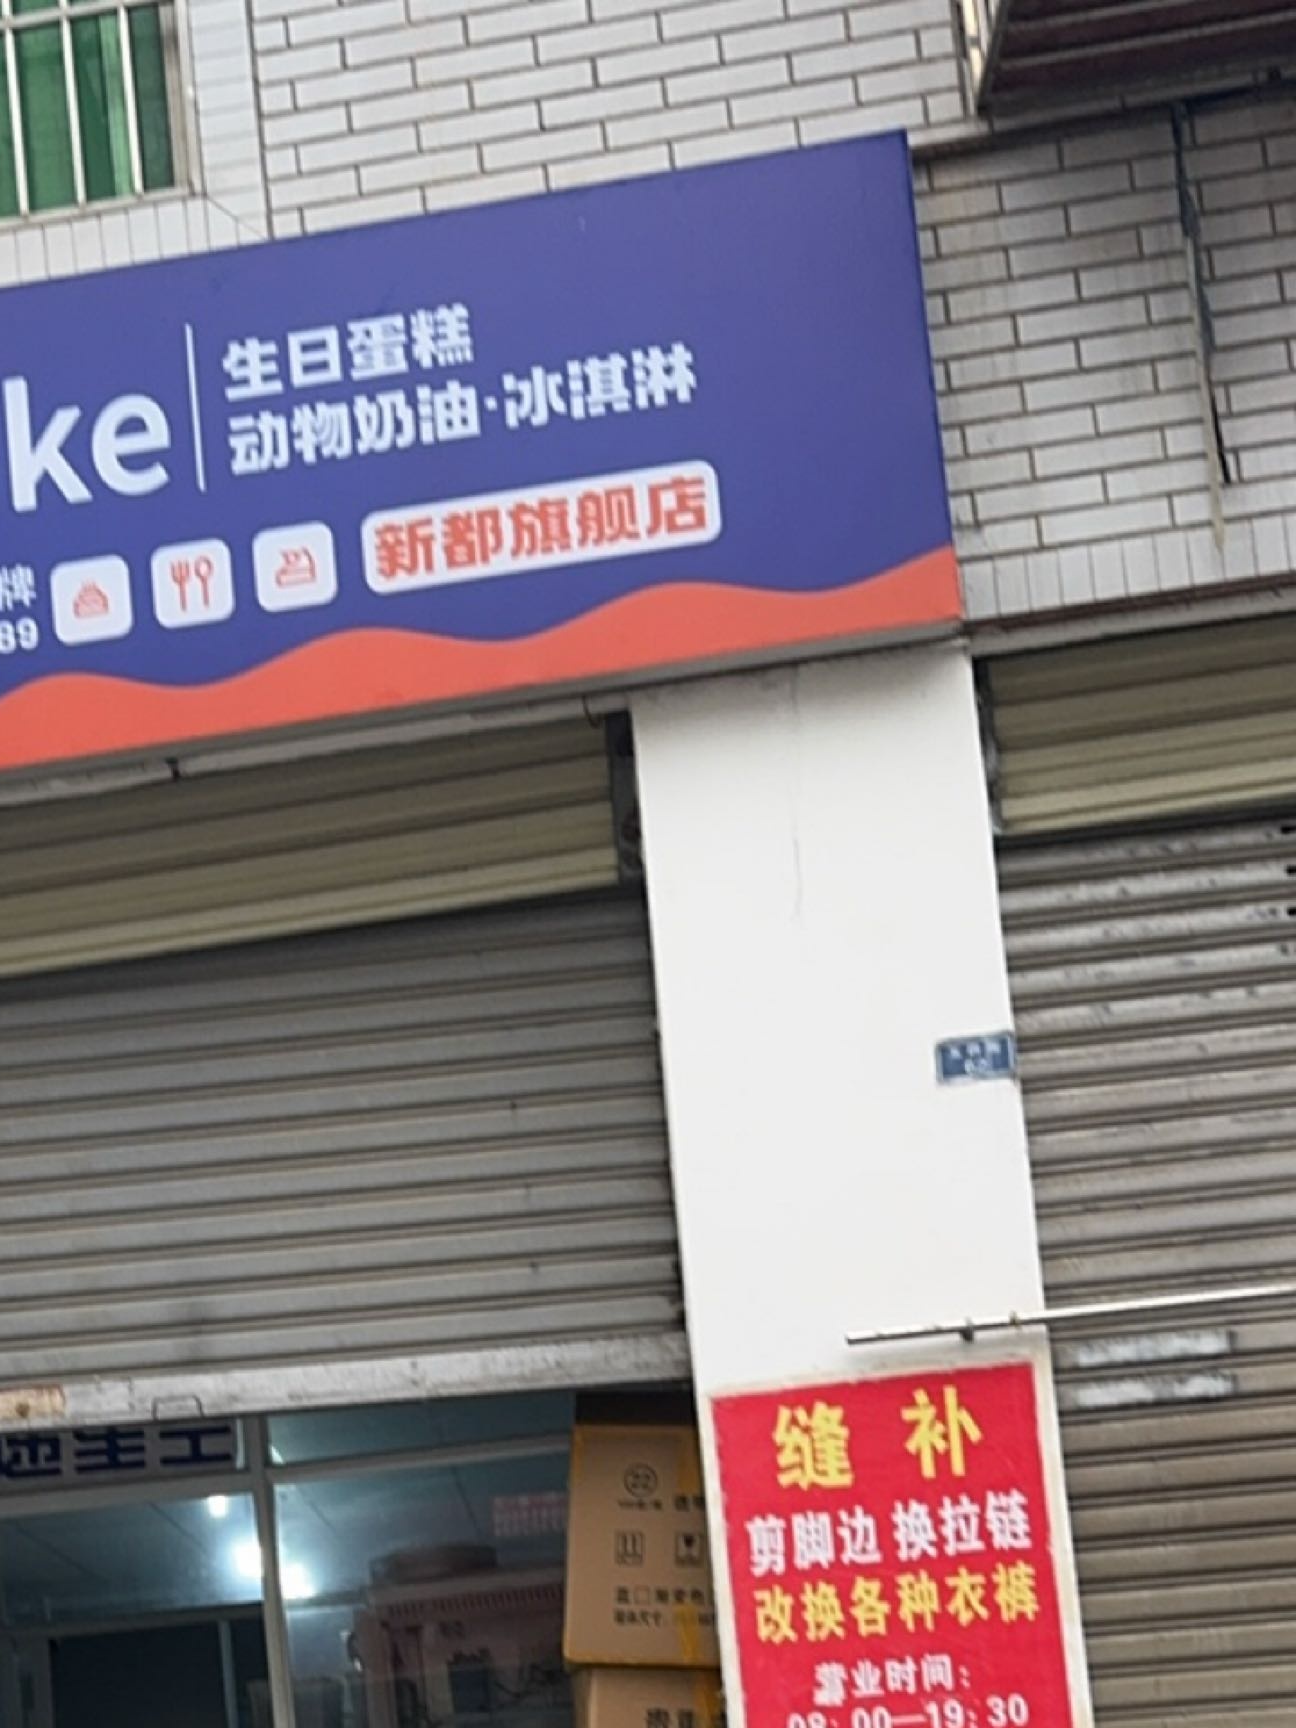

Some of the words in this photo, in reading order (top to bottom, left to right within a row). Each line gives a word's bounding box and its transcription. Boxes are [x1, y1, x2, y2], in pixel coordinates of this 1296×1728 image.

[221, 302, 475, 401] 生日蛋糕
[228, 342, 698, 476] 动物奶油·冰淇淋
[374, 473, 709, 580] 新都旗舰店
[891, 1488, 1034, 1562] 换拉链
